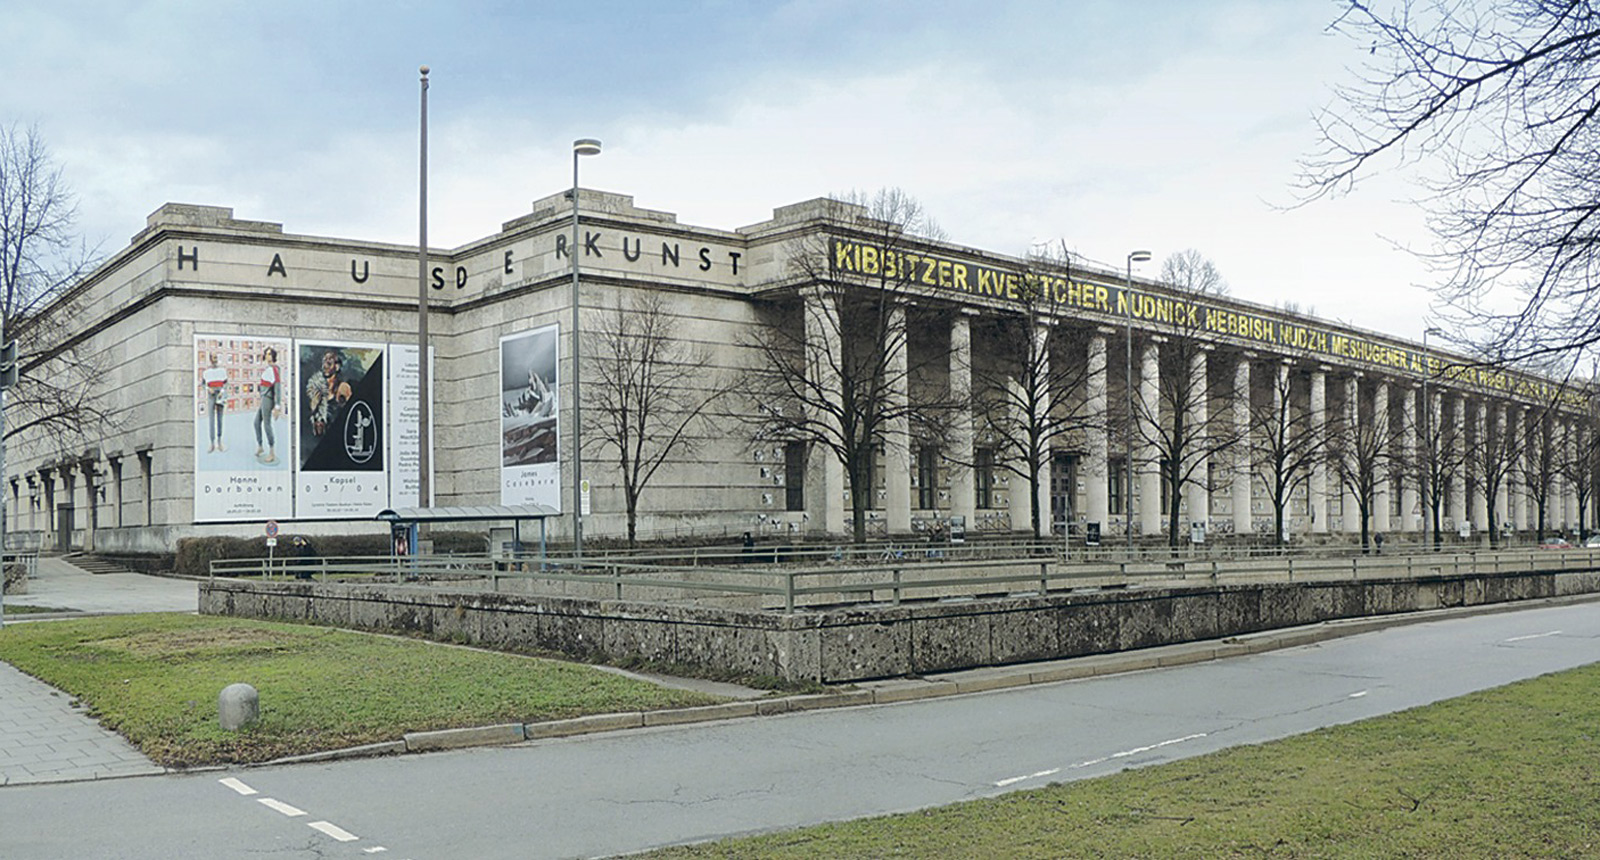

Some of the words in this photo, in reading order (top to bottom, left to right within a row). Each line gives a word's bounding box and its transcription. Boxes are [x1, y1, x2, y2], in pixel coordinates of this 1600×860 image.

[177, 245, 445, 290] HAUS
[456, 234, 569, 290] DER
[585, 231, 742, 275] KUNST
[977, 268, 1114, 314] KVETCHER,
[229, 475, 258, 484] Hanne
[329, 476, 356, 485] Kapsel
[204, 484, 283, 494] Darboven
